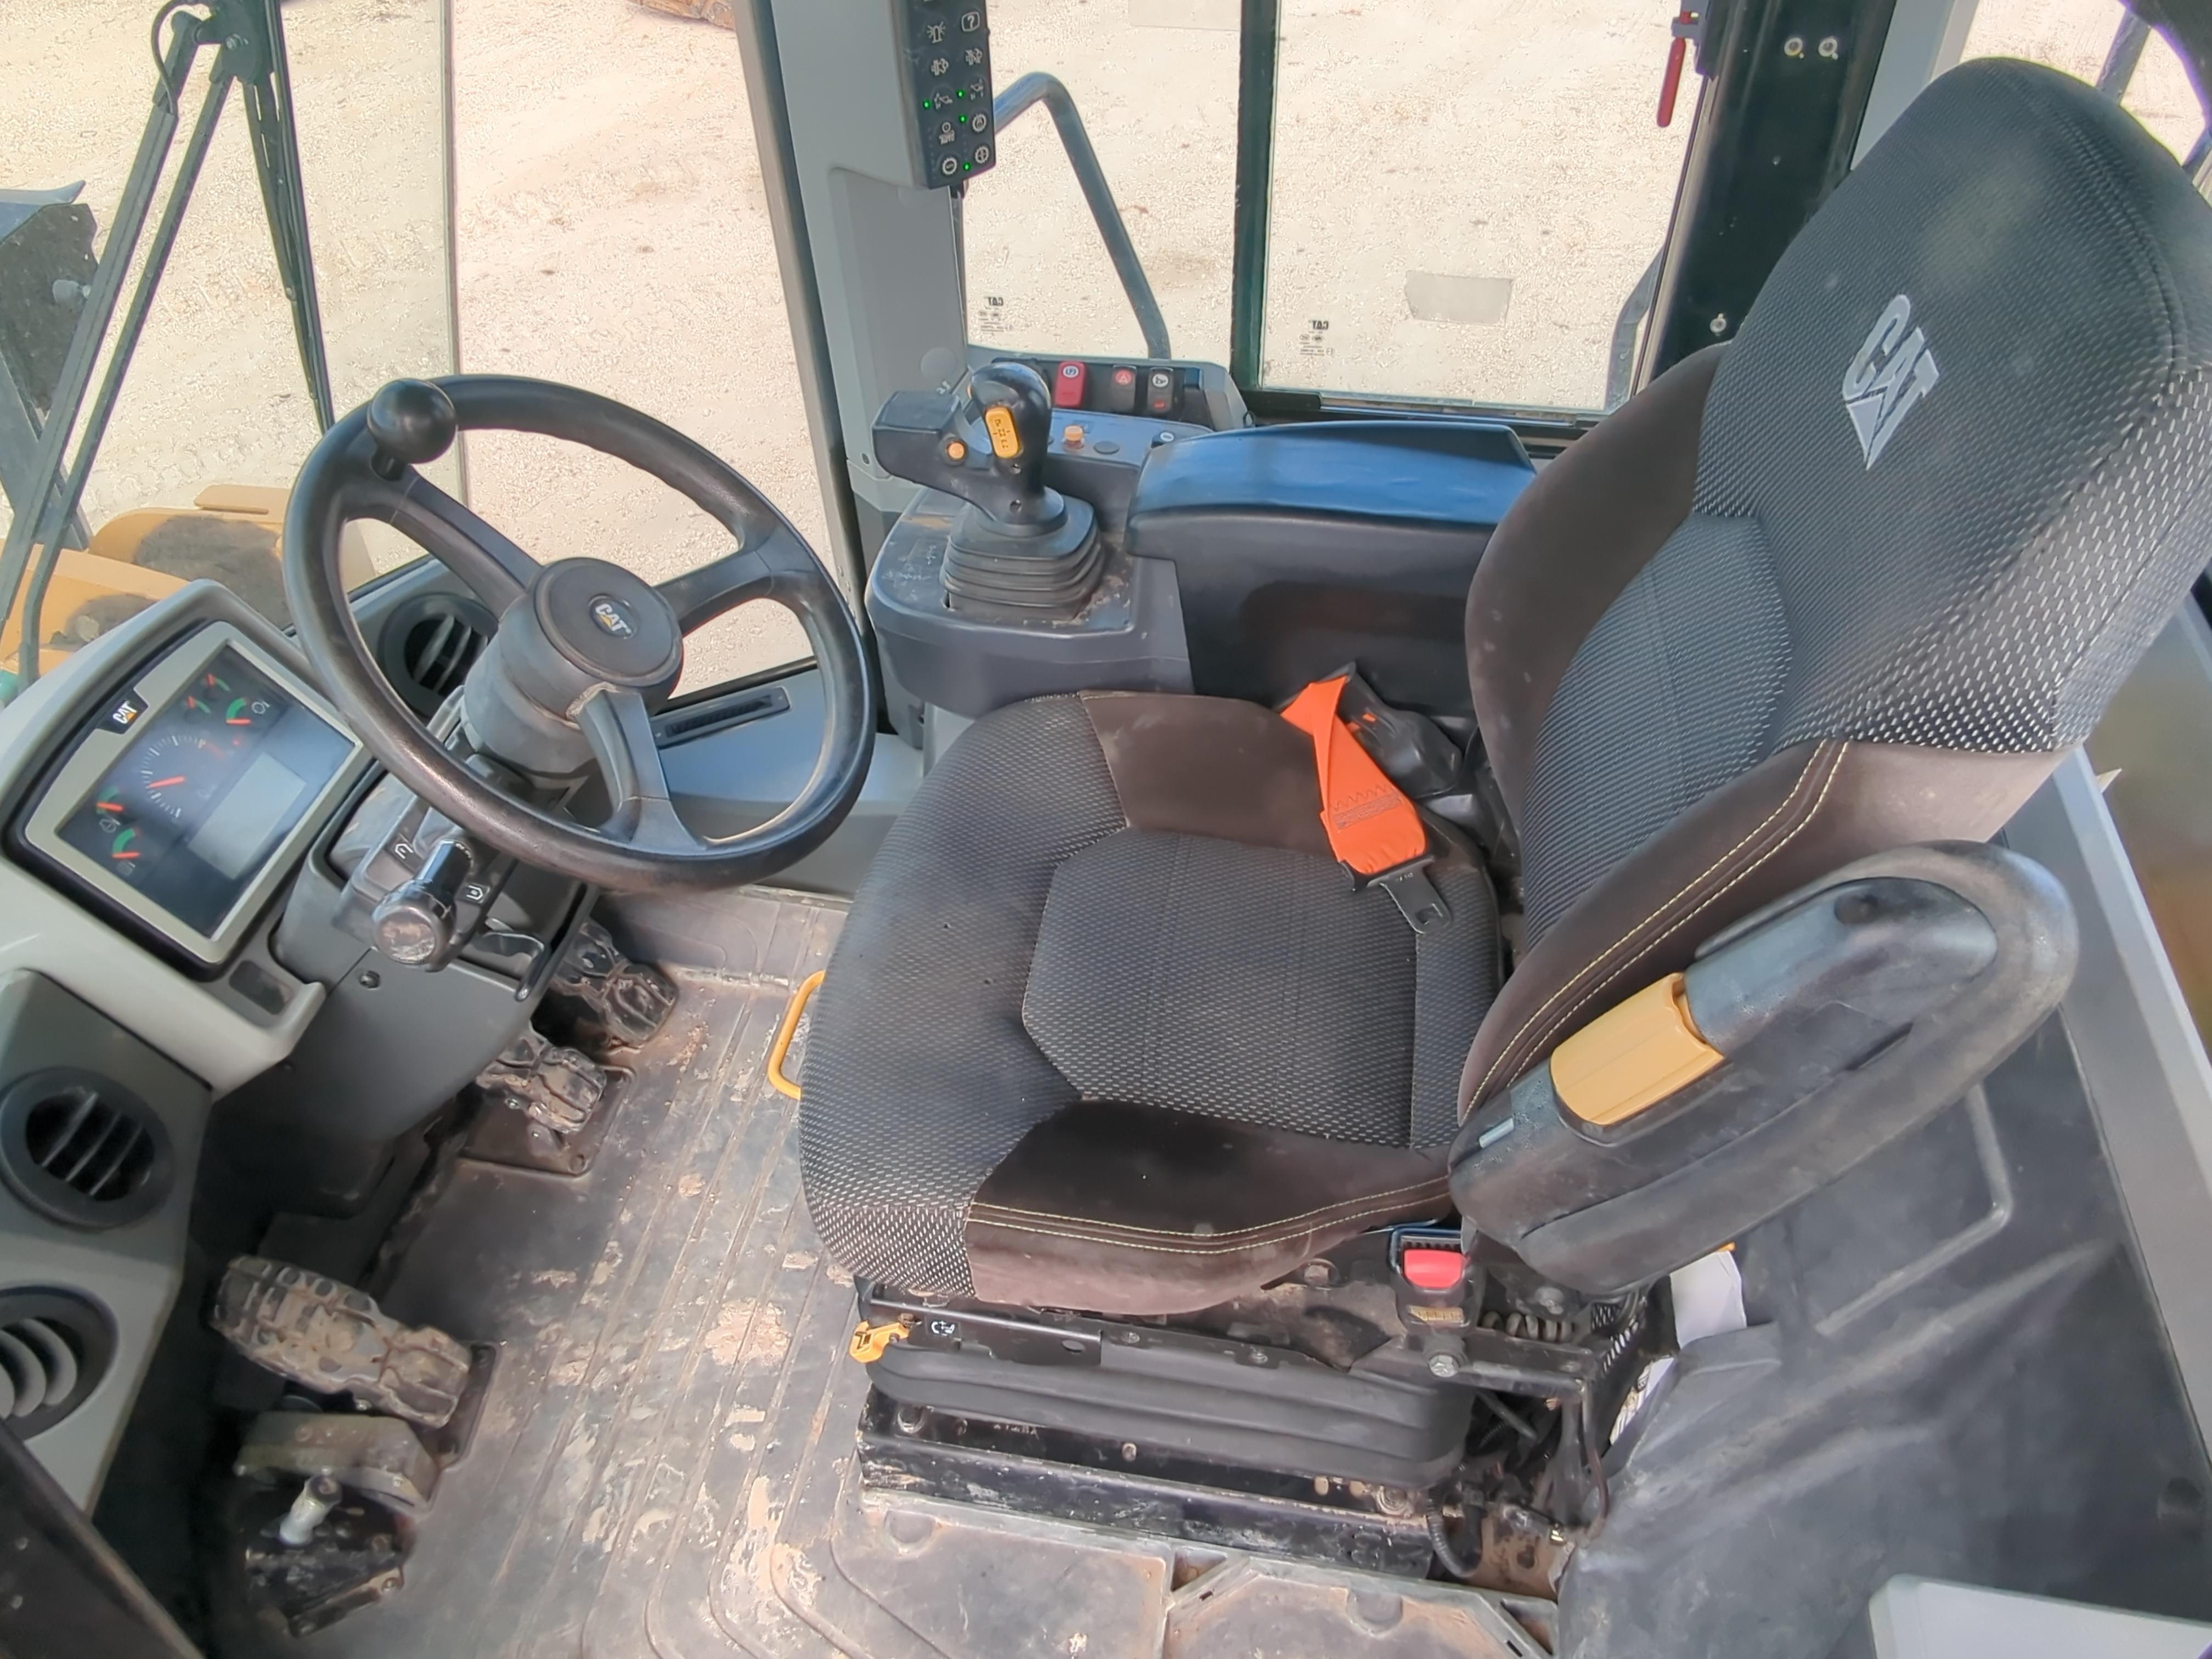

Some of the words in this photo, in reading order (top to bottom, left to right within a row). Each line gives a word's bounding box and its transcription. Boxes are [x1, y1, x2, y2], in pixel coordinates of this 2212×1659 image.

[1843, 294, 1939, 470] CAT
[595, 603, 628, 631] CAT
[112, 701, 137, 724] CAT
